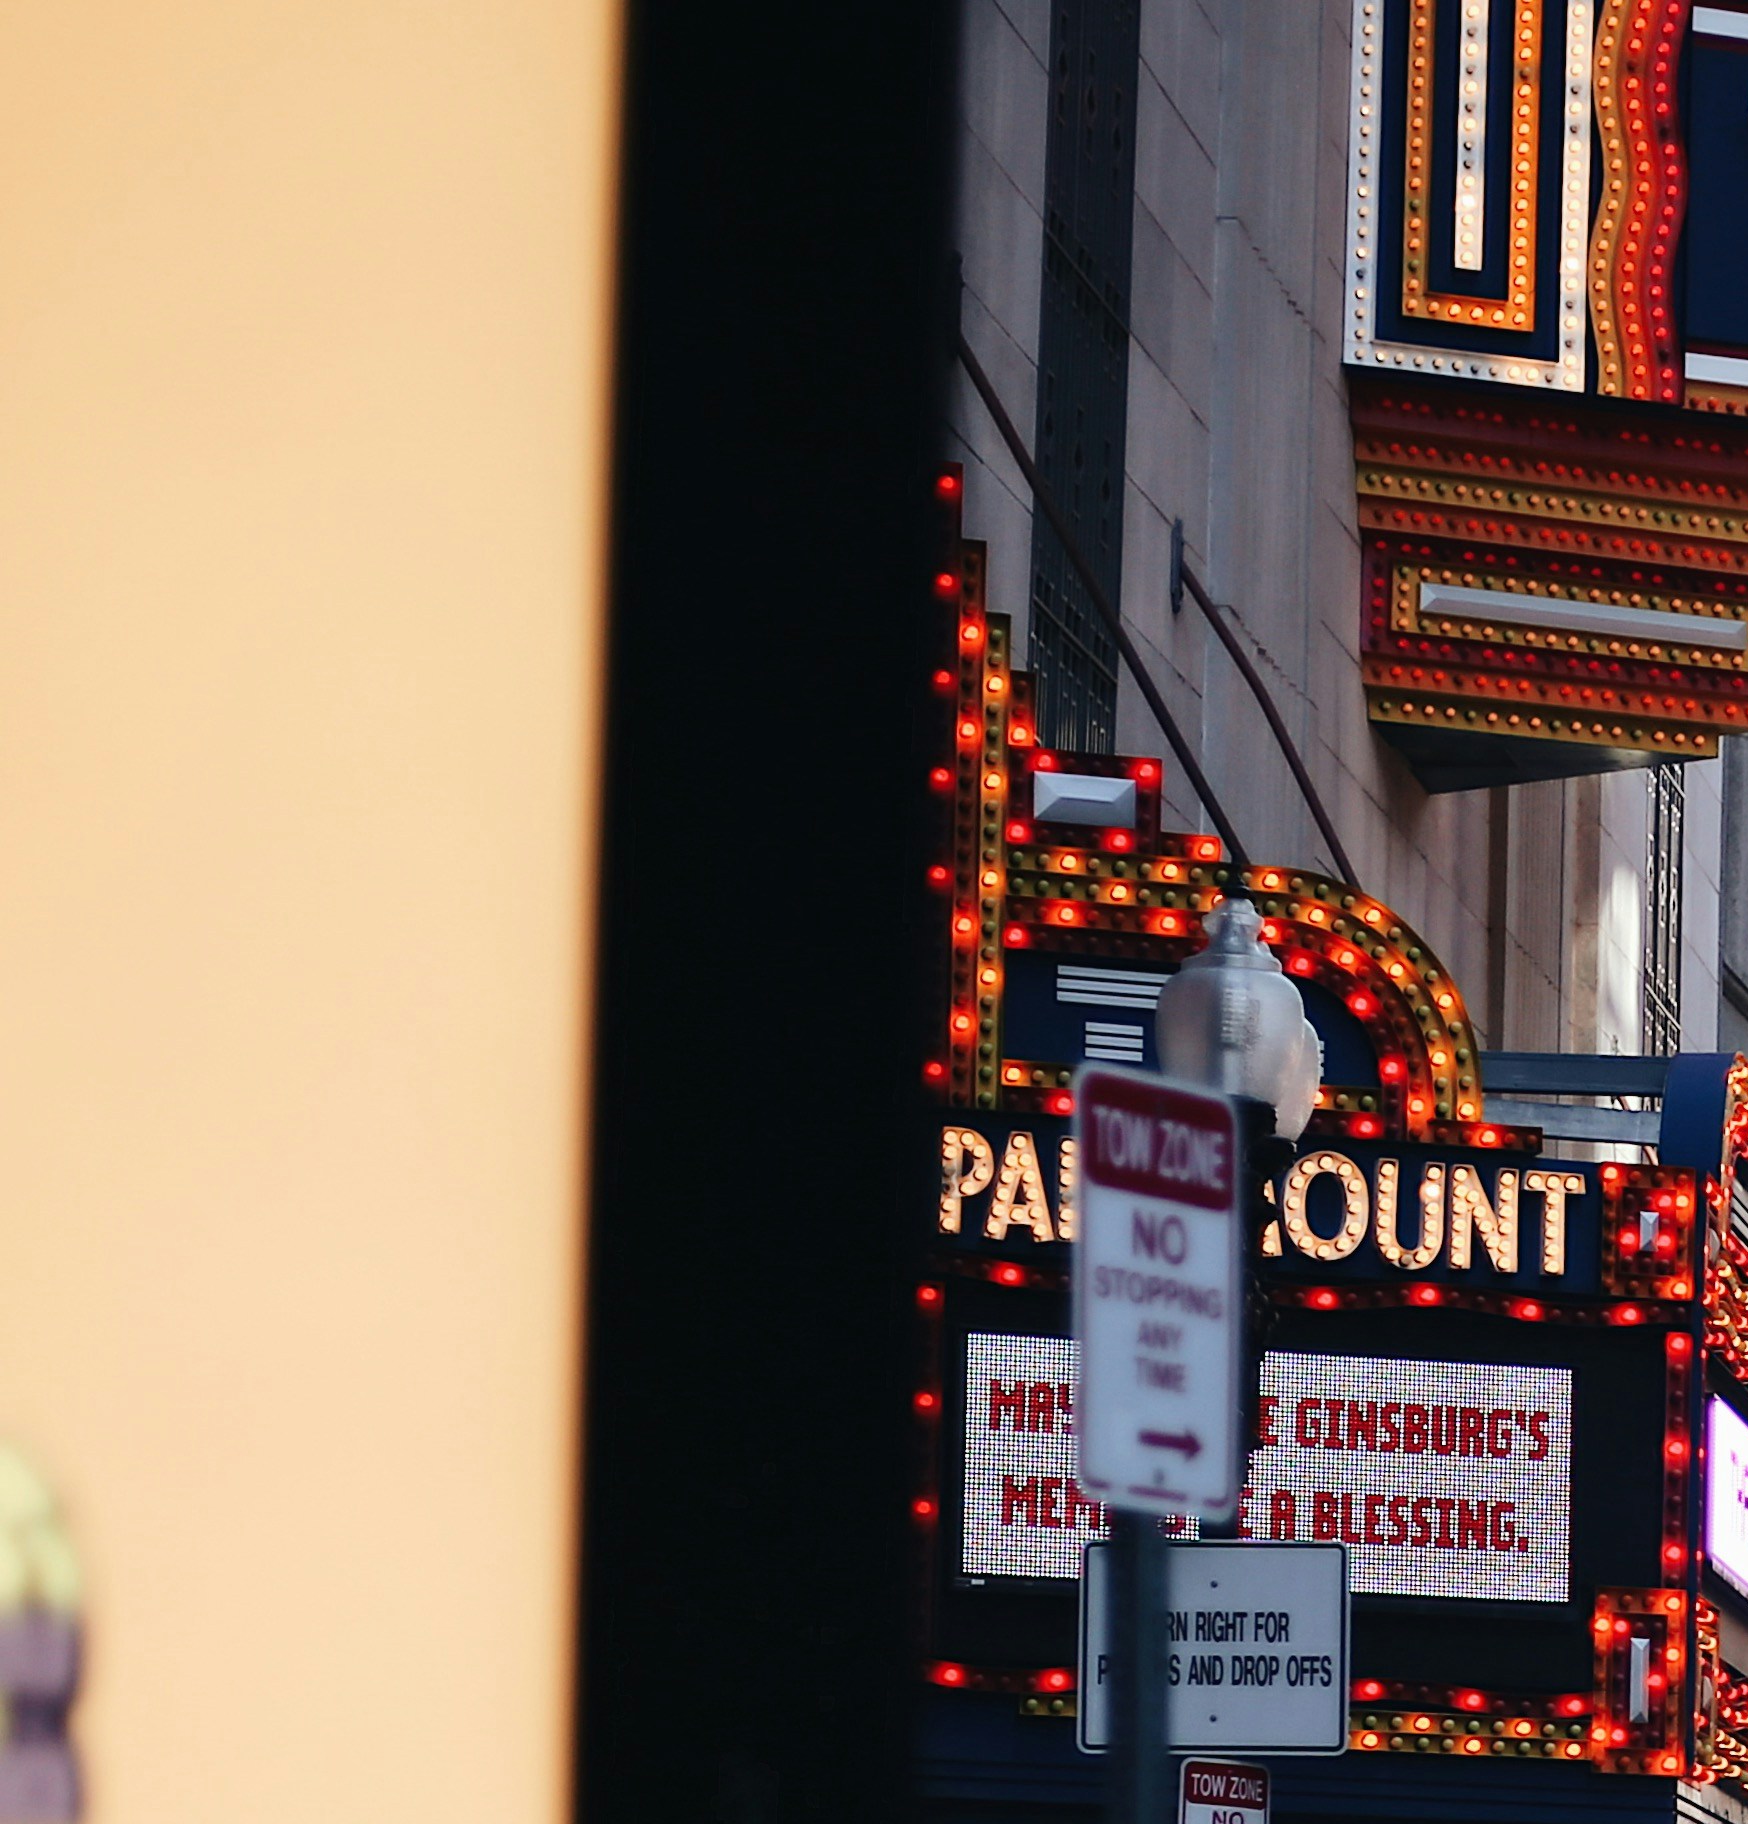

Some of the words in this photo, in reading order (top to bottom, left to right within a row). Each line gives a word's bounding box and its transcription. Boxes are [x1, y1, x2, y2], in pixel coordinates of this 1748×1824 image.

[1092, 1104, 1155, 1170] TOW
[1157, 1118, 1227, 1191] ZONE
[939, 1125, 1586, 1276] PAOUNT
[1131, 1211, 1187, 1266] NO
[1094, 1268, 1223, 1319] STOPPING
[1137, 1320, 1182, 1352] ANY
[1135, 1356, 1186, 1393] TIME
[1299, 1399, 1550, 1461] GINSBURG'S
[1262, 1494, 1296, 1541] A
[1307, 1497, 1530, 1555] BLESSING.
[1166, 1611, 1188, 1643] RN
[1195, 1610, 1248, 1643] RIGHT
[1253, 1612, 1290, 1644] FOR
[1187, 1655, 1224, 1687] AND
[1231, 1655, 1281, 1688] DROP
[1286, 1655, 1333, 1688] OFFS
[1191, 1773, 1226, 1799] TOW
[1229, 1775, 1263, 1802] ZONE
